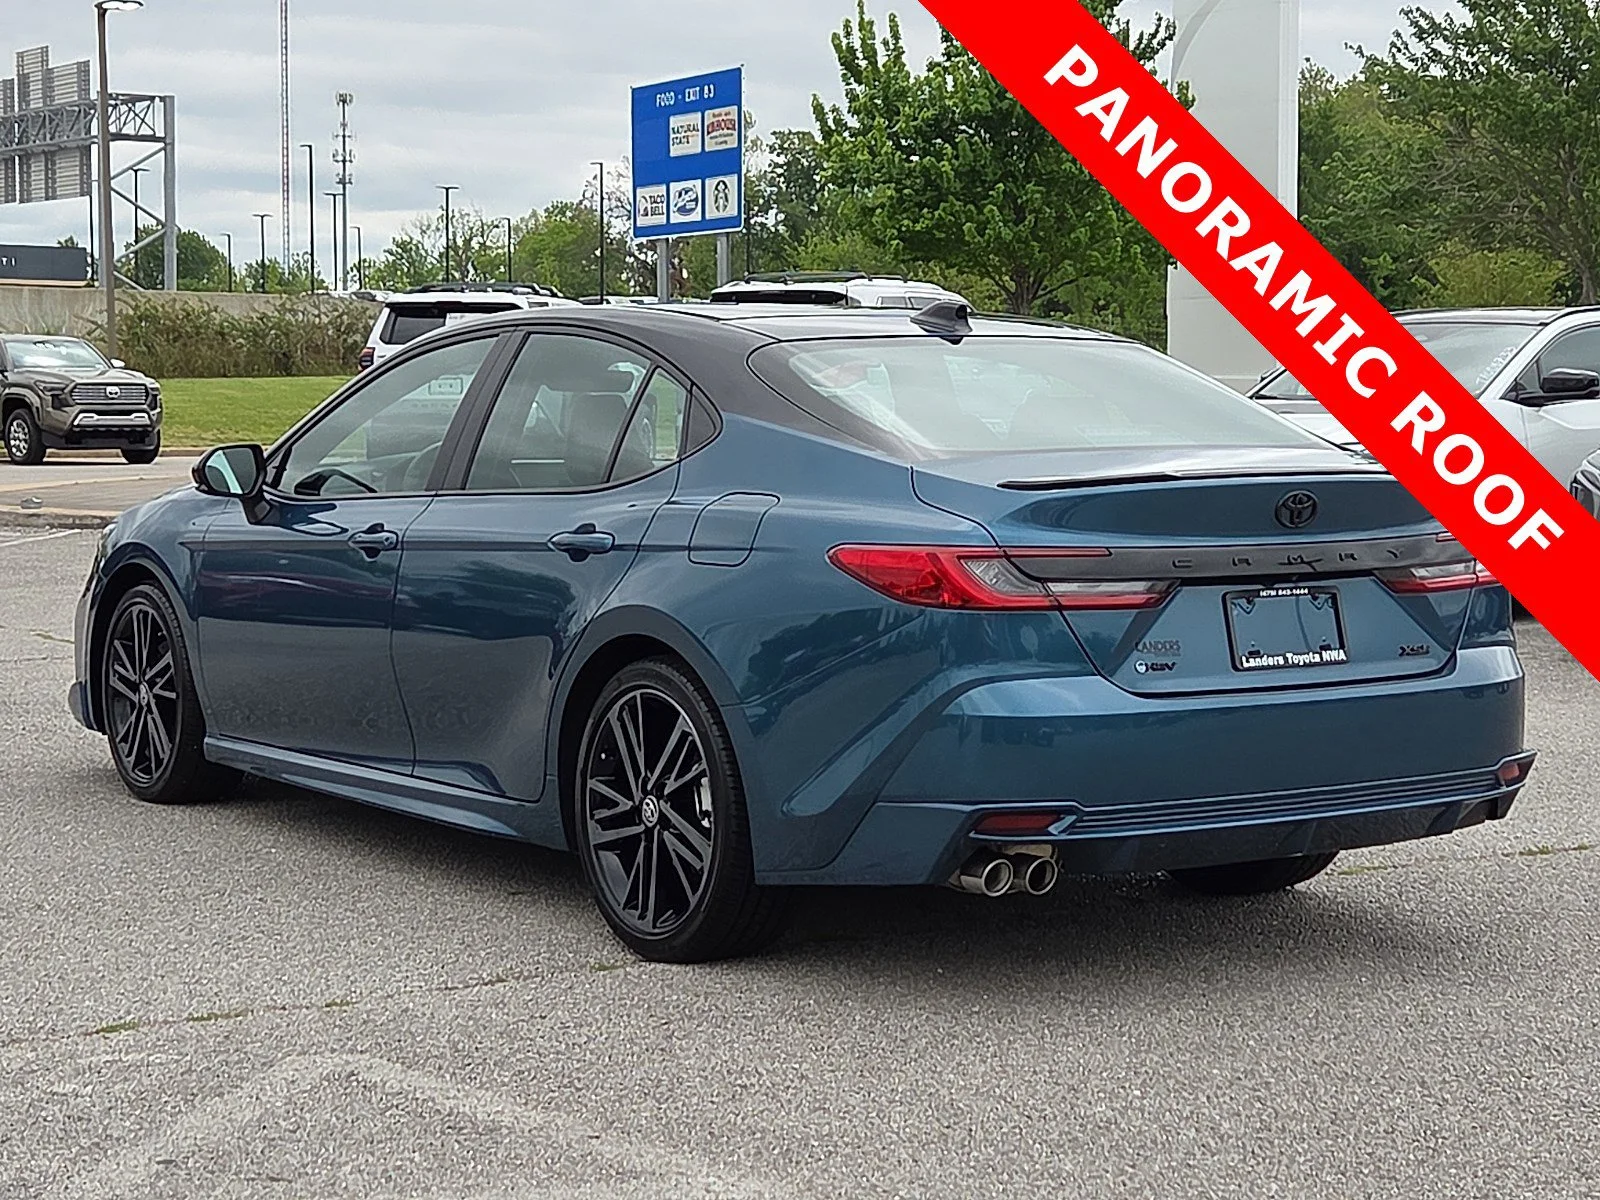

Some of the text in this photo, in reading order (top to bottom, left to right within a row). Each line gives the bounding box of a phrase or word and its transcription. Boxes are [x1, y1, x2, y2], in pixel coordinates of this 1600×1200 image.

[656, 91, 675, 107] FOOD
[685, 86, 700, 102] EXIT
[671, 123, 699, 134] NATURAL
[671, 134, 690, 146] STATE
[649, 194, 665, 205] TACO
[650, 205, 665, 216] BELL
[1172, 549, 1402, 567] CAMRY
[1135, 640, 1181, 652] LANDERS
[1241, 649, 1347, 668] Landers Toyota NWA
